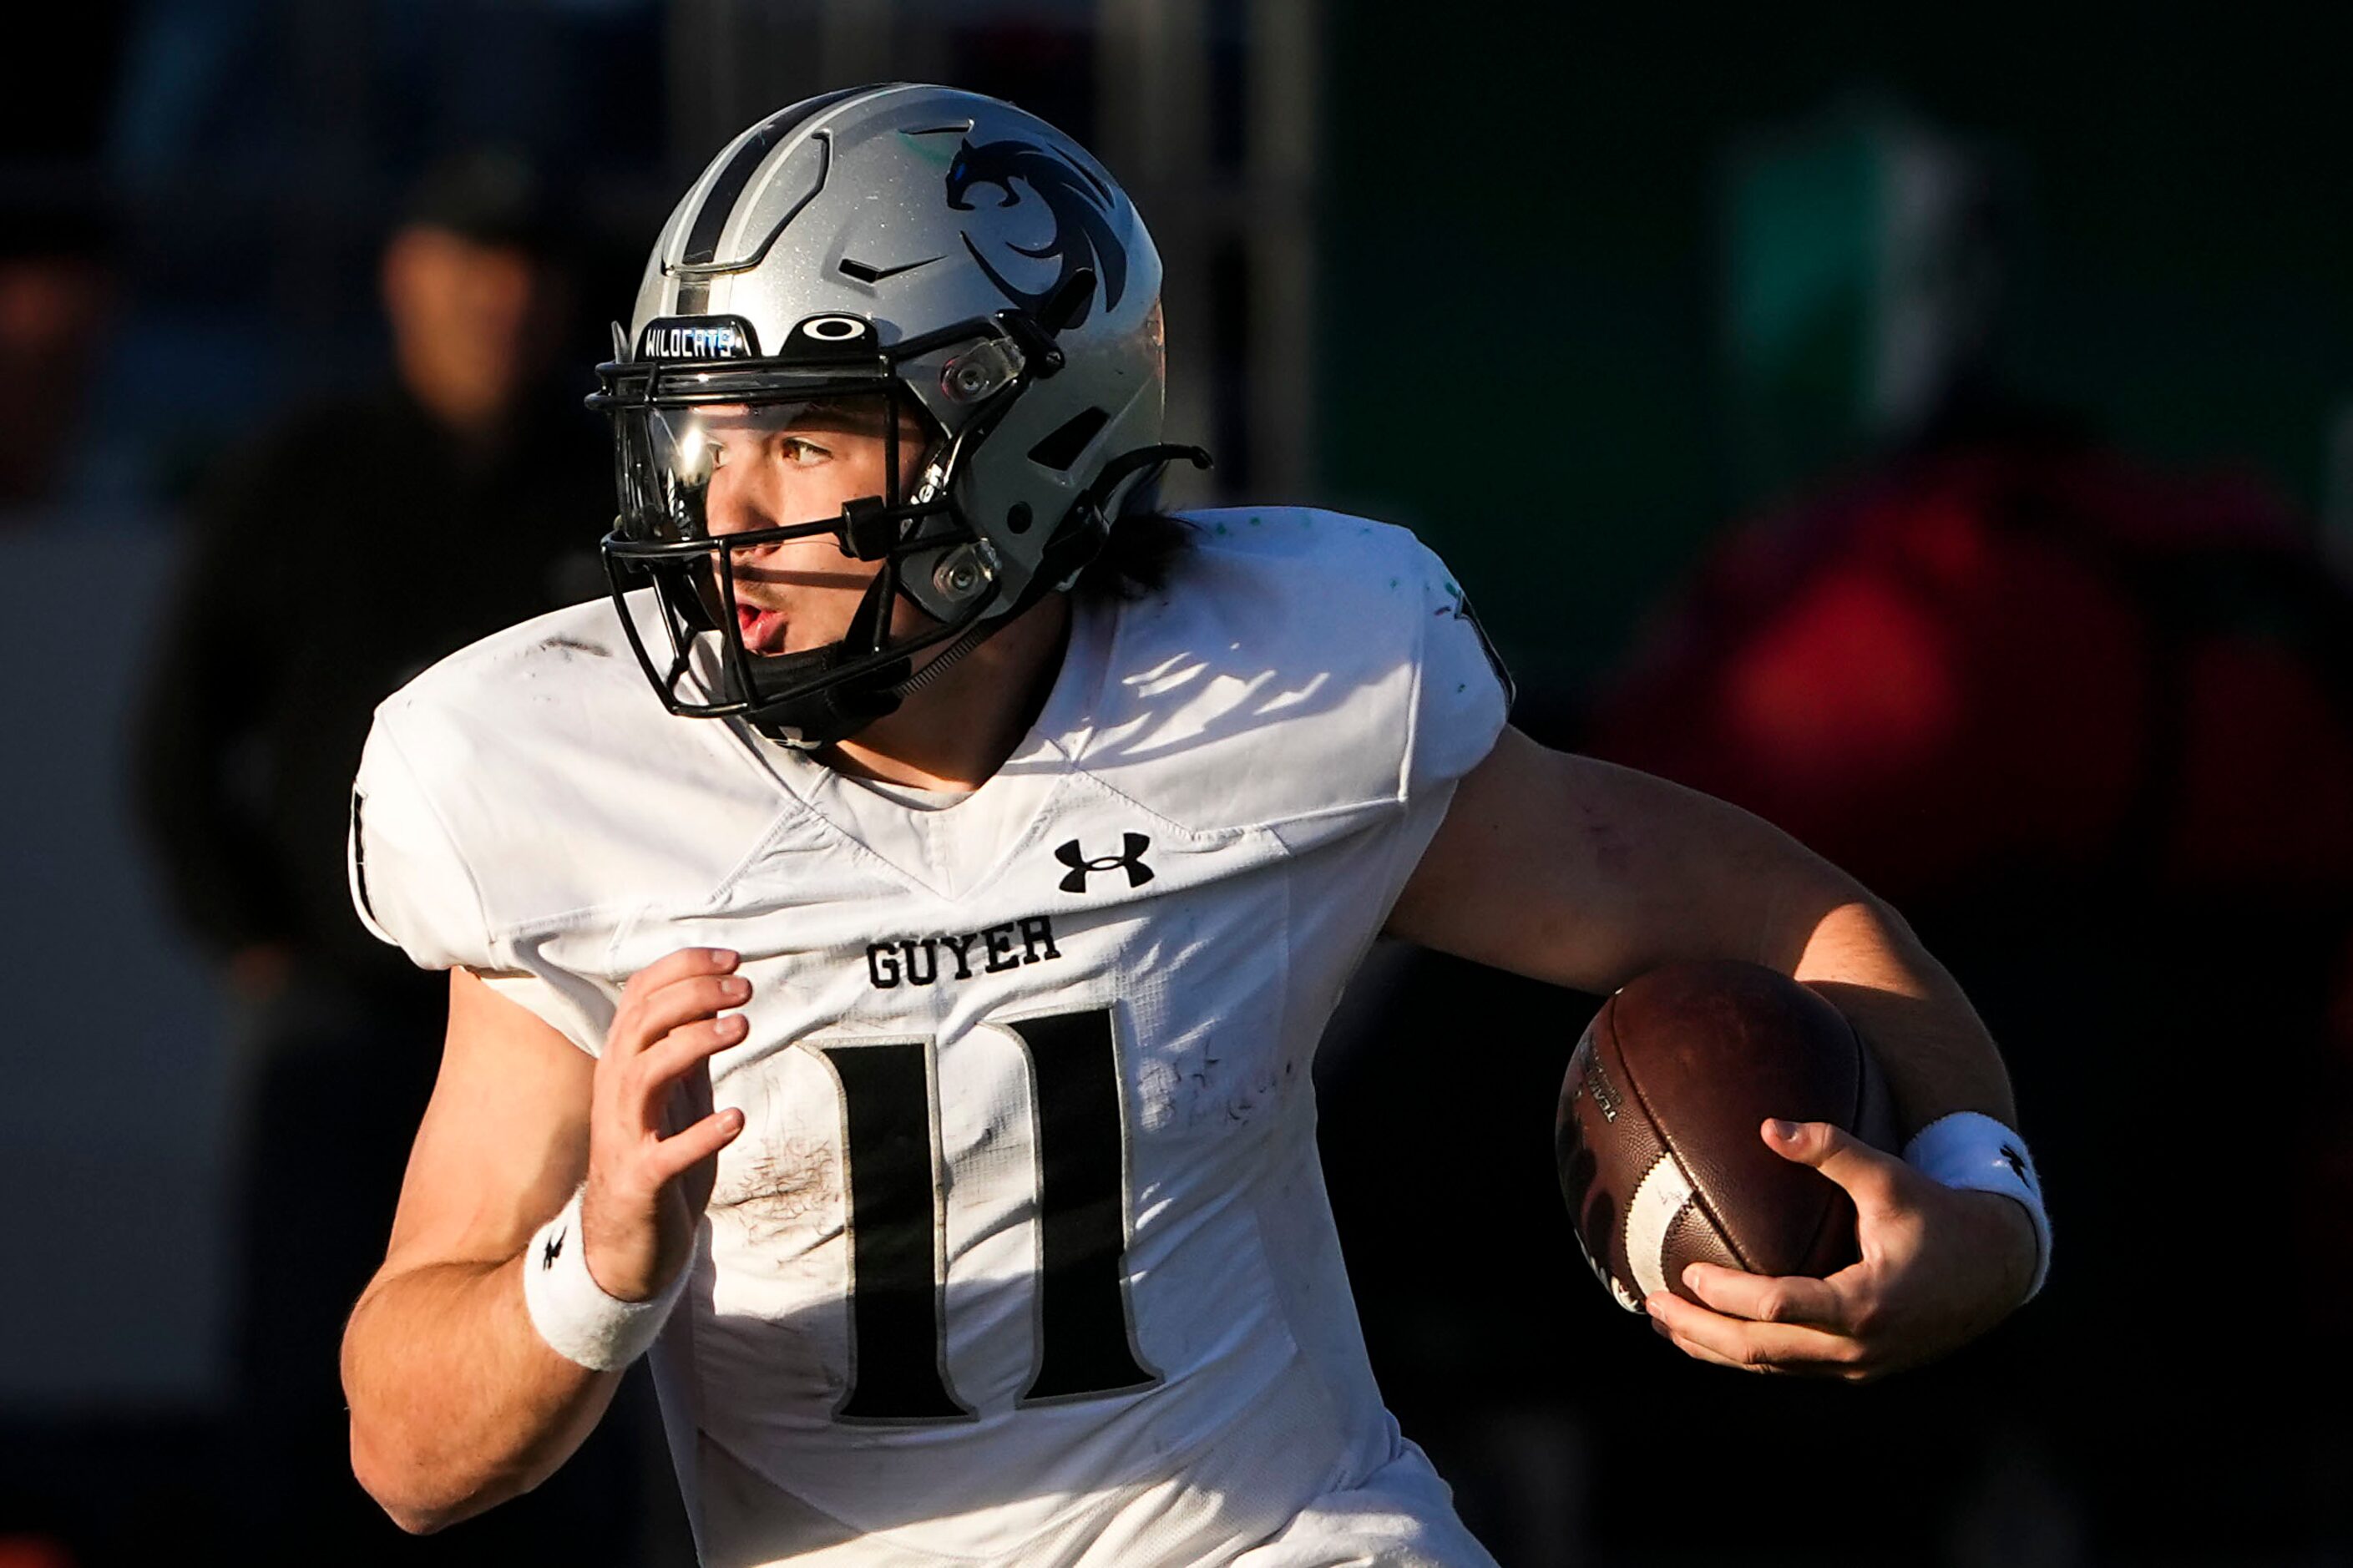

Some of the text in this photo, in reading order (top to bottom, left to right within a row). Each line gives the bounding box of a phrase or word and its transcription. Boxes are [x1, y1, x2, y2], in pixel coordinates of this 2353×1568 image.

[645, 328, 732, 357] WILDCATS
[866, 915, 1061, 989] GUYER
[795, 1001, 1165, 1424] 11
